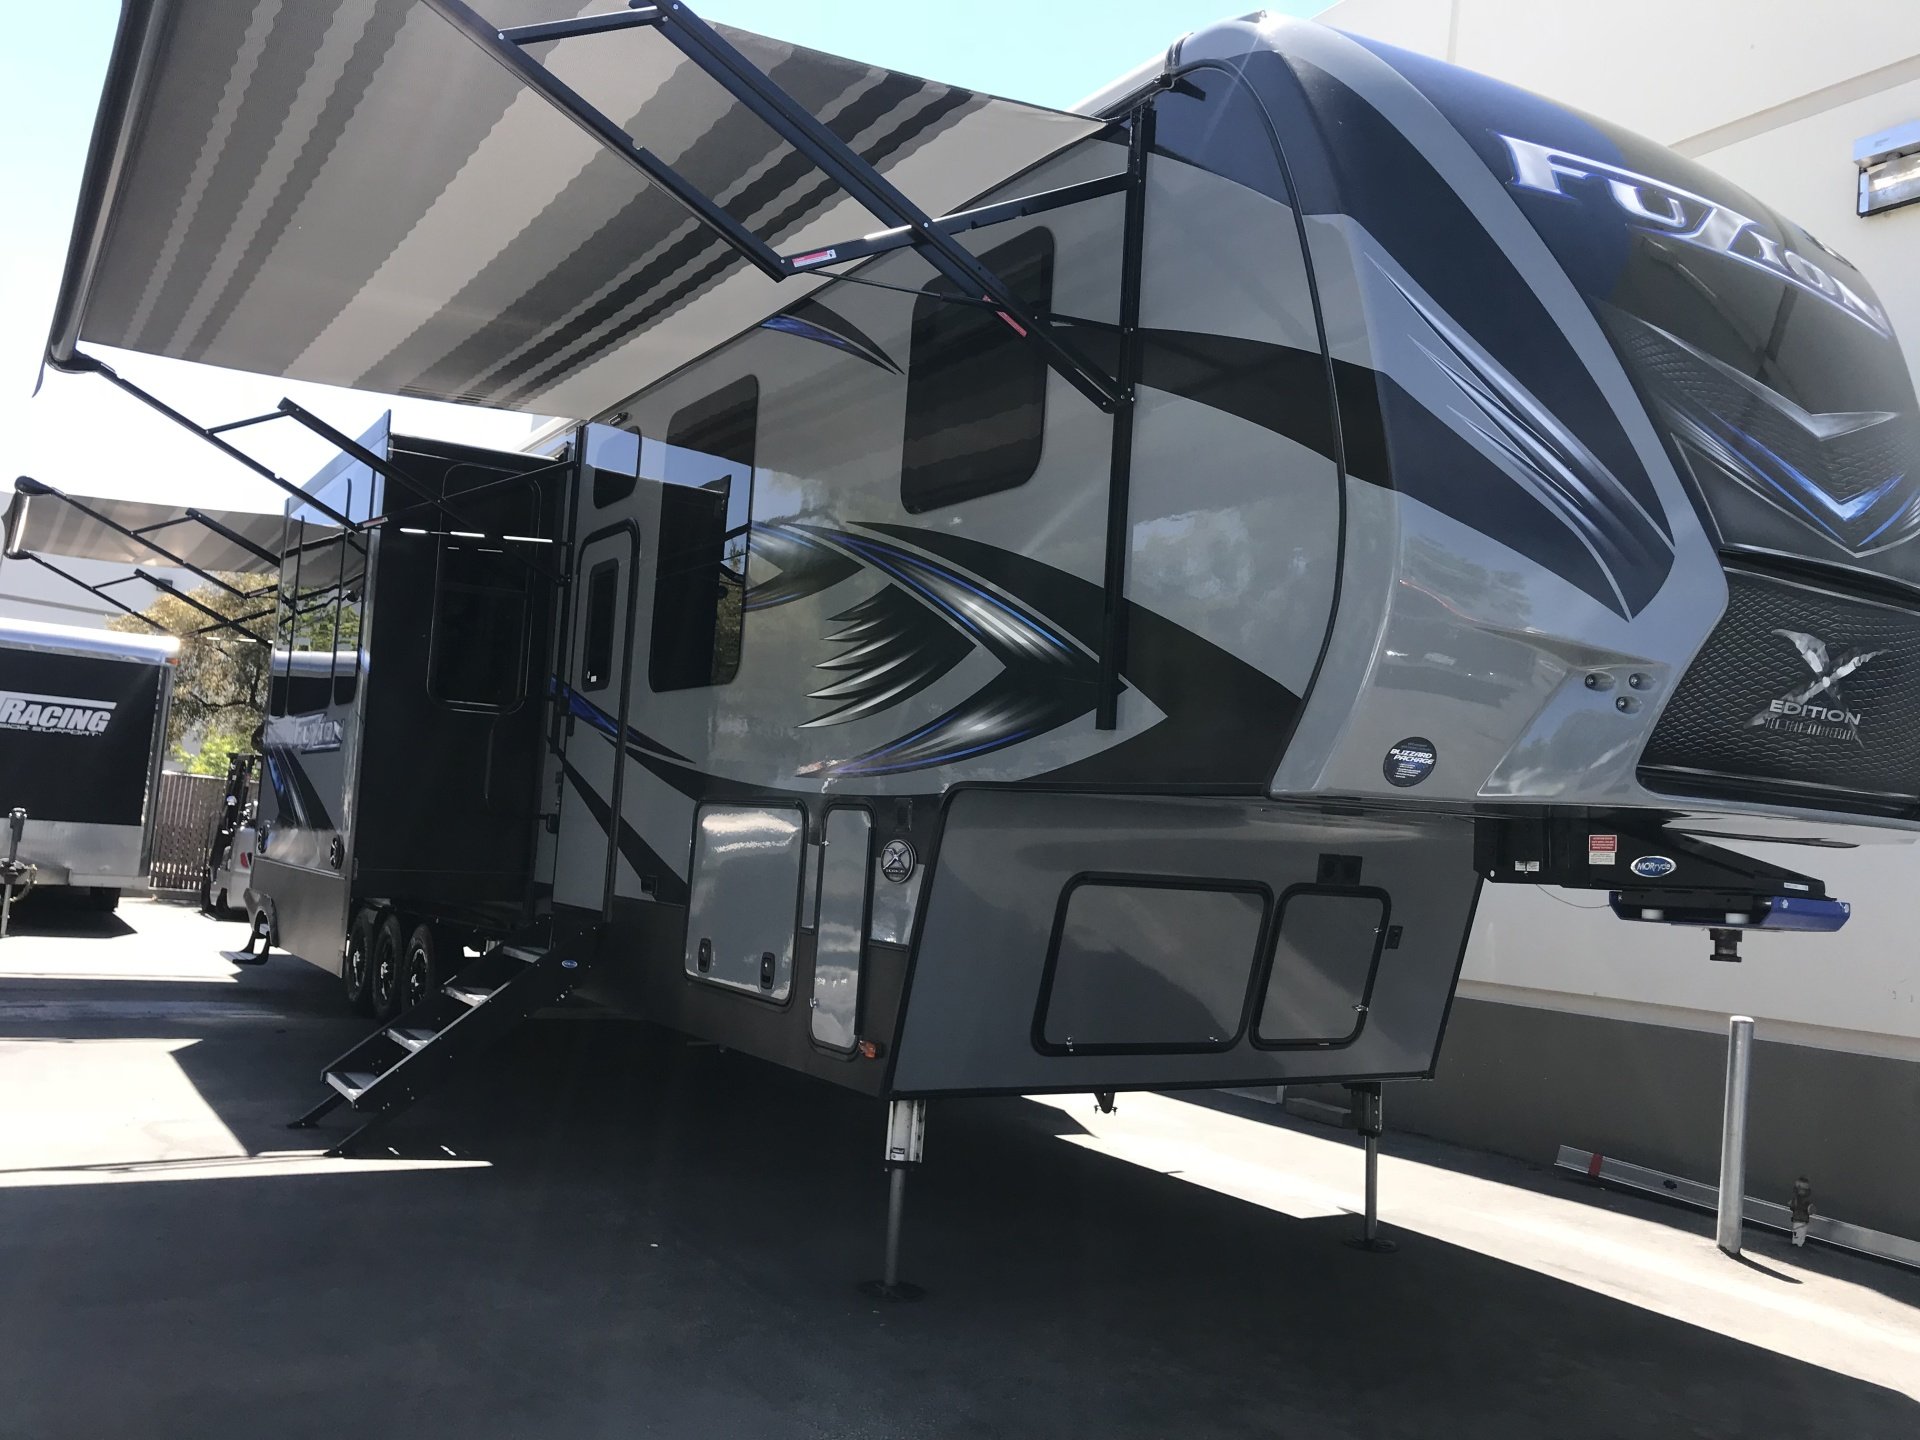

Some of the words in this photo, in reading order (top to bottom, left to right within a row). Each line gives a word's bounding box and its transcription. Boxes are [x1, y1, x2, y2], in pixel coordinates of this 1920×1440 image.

[0, 698, 111, 733] RACING
[1769, 699, 1861, 725] EDITION
[1390, 748, 1432, 759] BLIZZARD
[1394, 754, 1434, 765] PACKAGE
